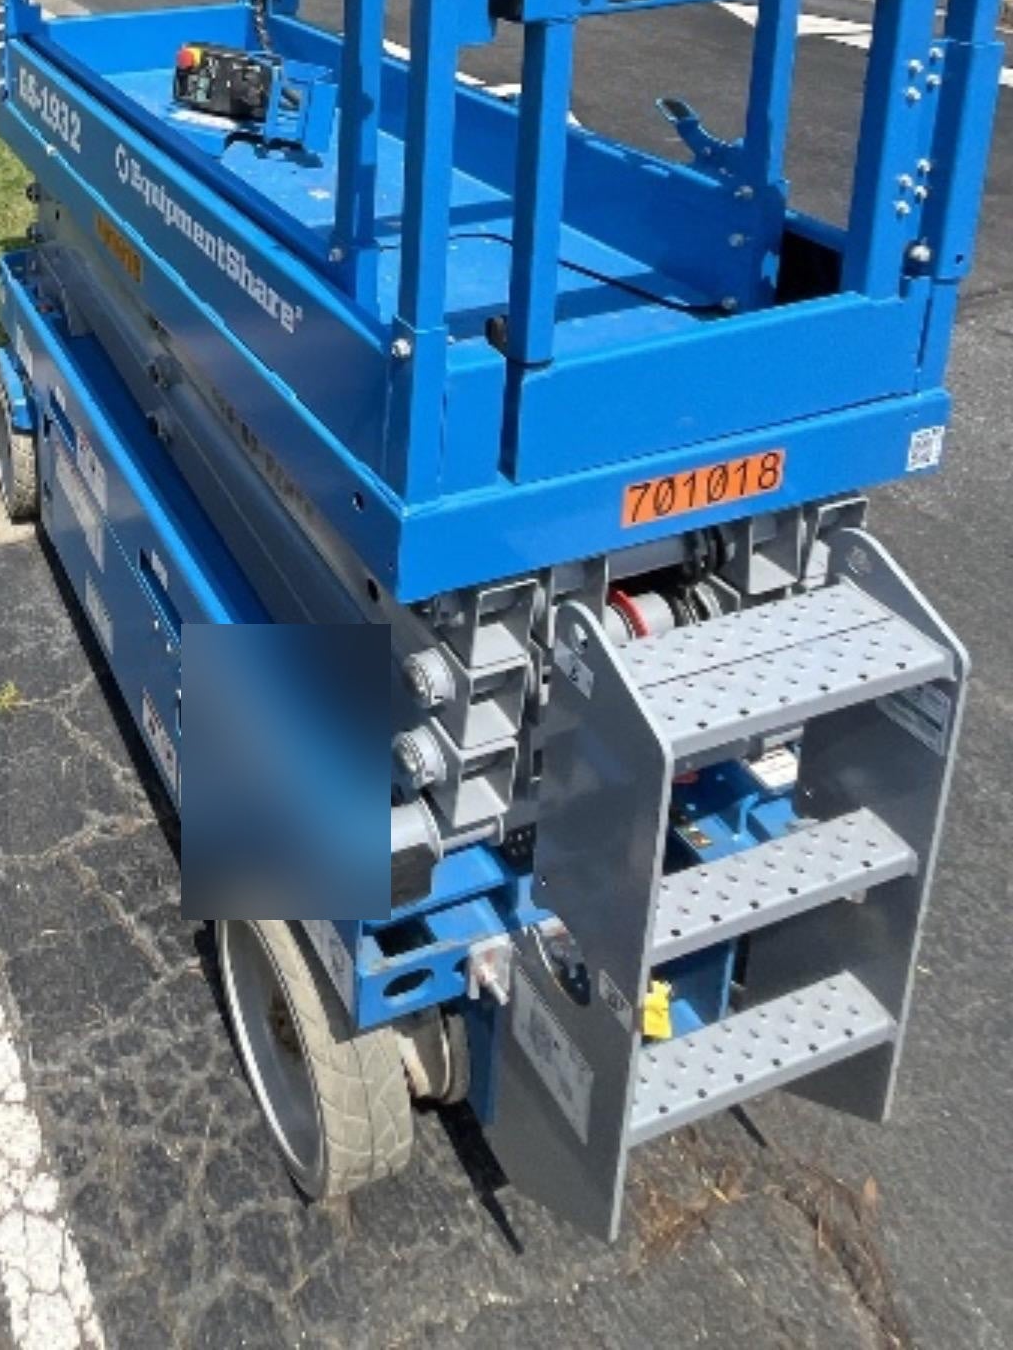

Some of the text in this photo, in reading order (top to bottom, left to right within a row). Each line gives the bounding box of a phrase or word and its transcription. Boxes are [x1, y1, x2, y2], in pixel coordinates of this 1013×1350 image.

[18, 66, 82, 154] GS-1932
[130, 157, 296, 334] EquipmentShare
[627, 452, 782, 523] 701018
